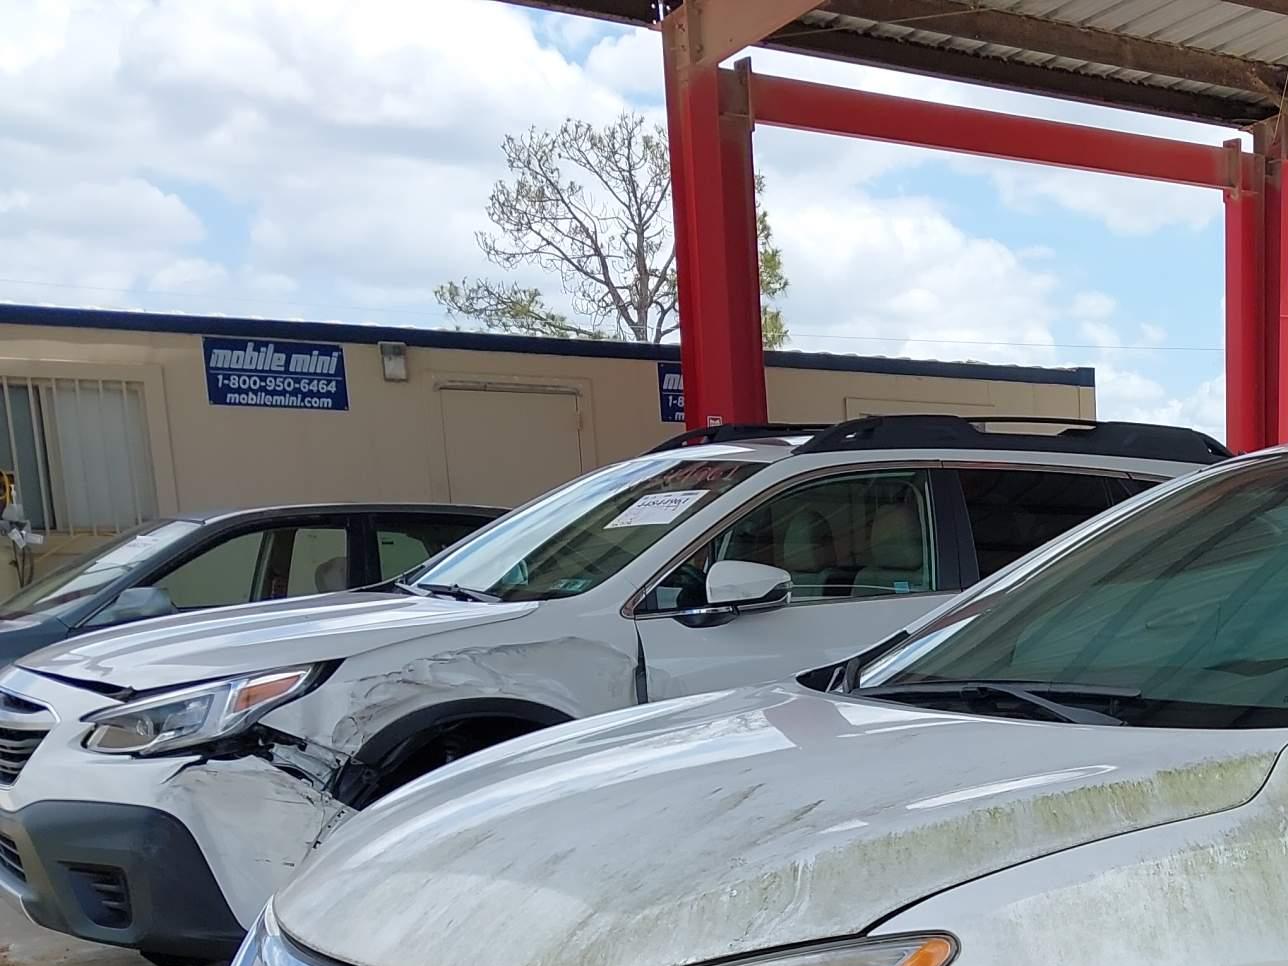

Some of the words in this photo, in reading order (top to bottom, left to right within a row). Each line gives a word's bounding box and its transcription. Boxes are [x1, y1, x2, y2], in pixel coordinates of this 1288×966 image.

[209, 342, 286, 371] mobile
[288, 350, 339, 374] mini
[216, 374, 337, 393] 1-800-950-6464
[226, 392, 332, 408] mobilemini.com
